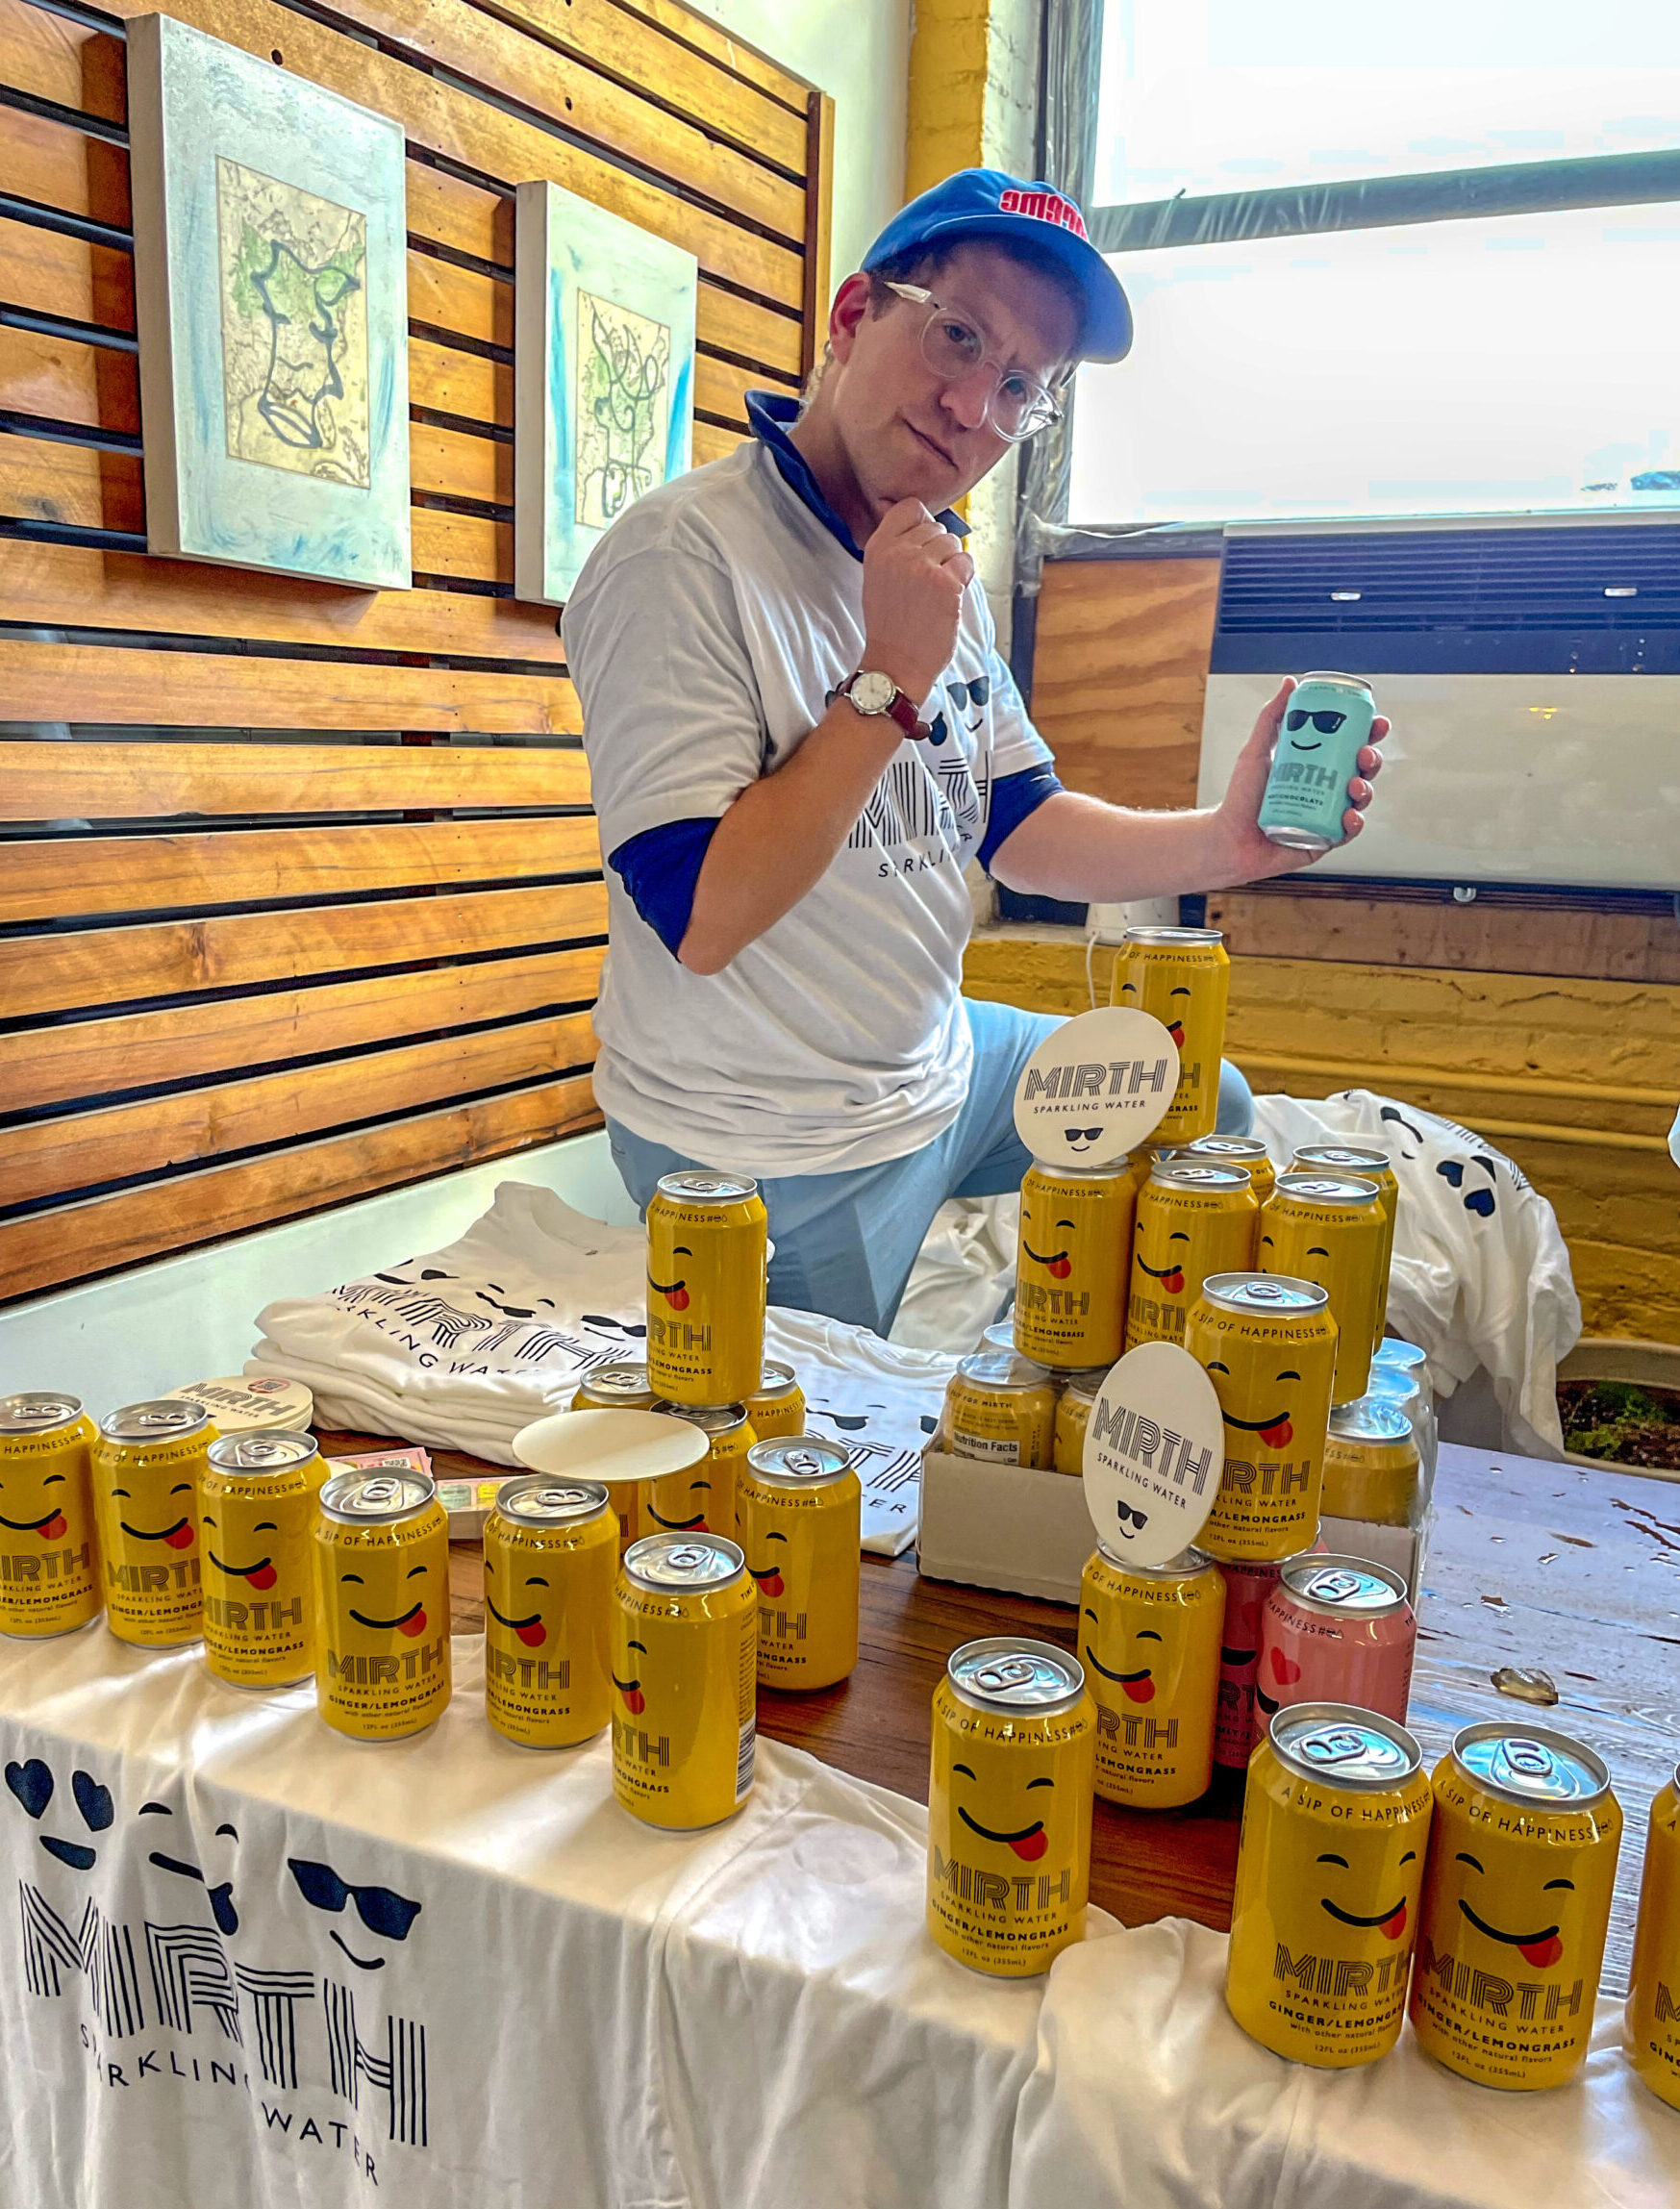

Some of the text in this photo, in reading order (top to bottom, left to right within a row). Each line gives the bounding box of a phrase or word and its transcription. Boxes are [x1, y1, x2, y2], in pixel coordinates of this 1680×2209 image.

[1274, 762, 1338, 791] IRTH
[1024, 1059, 1167, 1100] MIRTH
[1034, 1100, 1145, 1114] SPARKLING WATER
[649, 1314, 712, 1351] RTH
[1198, 1314, 1215, 1325] SIP
[1217, 1320, 1235, 1332] OF
[669, 1351, 699, 1361] WATER
[180, 1383, 296, 1416] MIRTH
[113, 1453, 127, 1463] OF
[990, 1442, 1017, 1452] Facts
[1092, 1396, 1213, 1496] MIRTH
[206, 1480, 218, 1490] OF
[1096, 1452, 1186, 1510] SPARKLING WATER
[1222, 1458, 1311, 1495] RTH
[1209, 1520, 1230, 1529] other
[1210, 1509, 1306, 1523] R/LEMONGRASS
[325, 1530, 339, 1542] SIP
[343, 1536, 361, 1546] OF
[0, 1542, 90, 1582] IRTH
[1092, 1571, 1105, 1582] OF
[254, 1632, 291, 1641] WATER
[761, 1638, 793, 1650] WATER
[328, 1636, 443, 1685] MIRTH
[487, 1645, 569, 1690] IRTH
[329, 1680, 444, 1710] GINGER/LEMONGRASS
[339, 1673, 436, 1695] SPARKLING WATER
[520, 1693, 557, 1701] WATER
[936, 1696, 943, 1707] A
[941, 1705, 956, 1720] SIP
[960, 1719, 978, 1733] OF
[1095, 1702, 1178, 1748] RTH
[625, 1759, 656, 1777] WATER
[1095, 1754, 1177, 1774] LEMONGRASS
[1123, 1749, 1163, 1760] WATER
[1281, 1787, 1291, 1798] A
[1297, 1795, 1322, 1811] SIP
[1331, 1805, 1353, 1820] OF
[1446, 1788, 1465, 1806] SIP
[1469, 1805, 1491, 1823] OF
[935, 1845, 1070, 1911] MIRTH
[932, 1899, 1068, 1941] GINGER/LEMONGRASS
[940, 1891, 1057, 1924] SPARKLING WATER
[962, 1934, 983, 1945] other
[987, 1942, 1017, 1951] natural
[1422, 1935, 1583, 2021] MIRTH
[19, 1878, 427, 2147] MIRTH
[1286, 1990, 1367, 2011] SPARKLING
[1430, 1987, 1565, 2035] SPARKLING WATER
[1291, 2022, 1375, 2039] with other natural
[1417, 1993, 1575, 2052] GINGER/LEMONGRASS
[1432, 2022, 1449, 2037] with
[1452, 2035, 1478, 2050] other
[1482, 2048, 1517, 2063] natural
